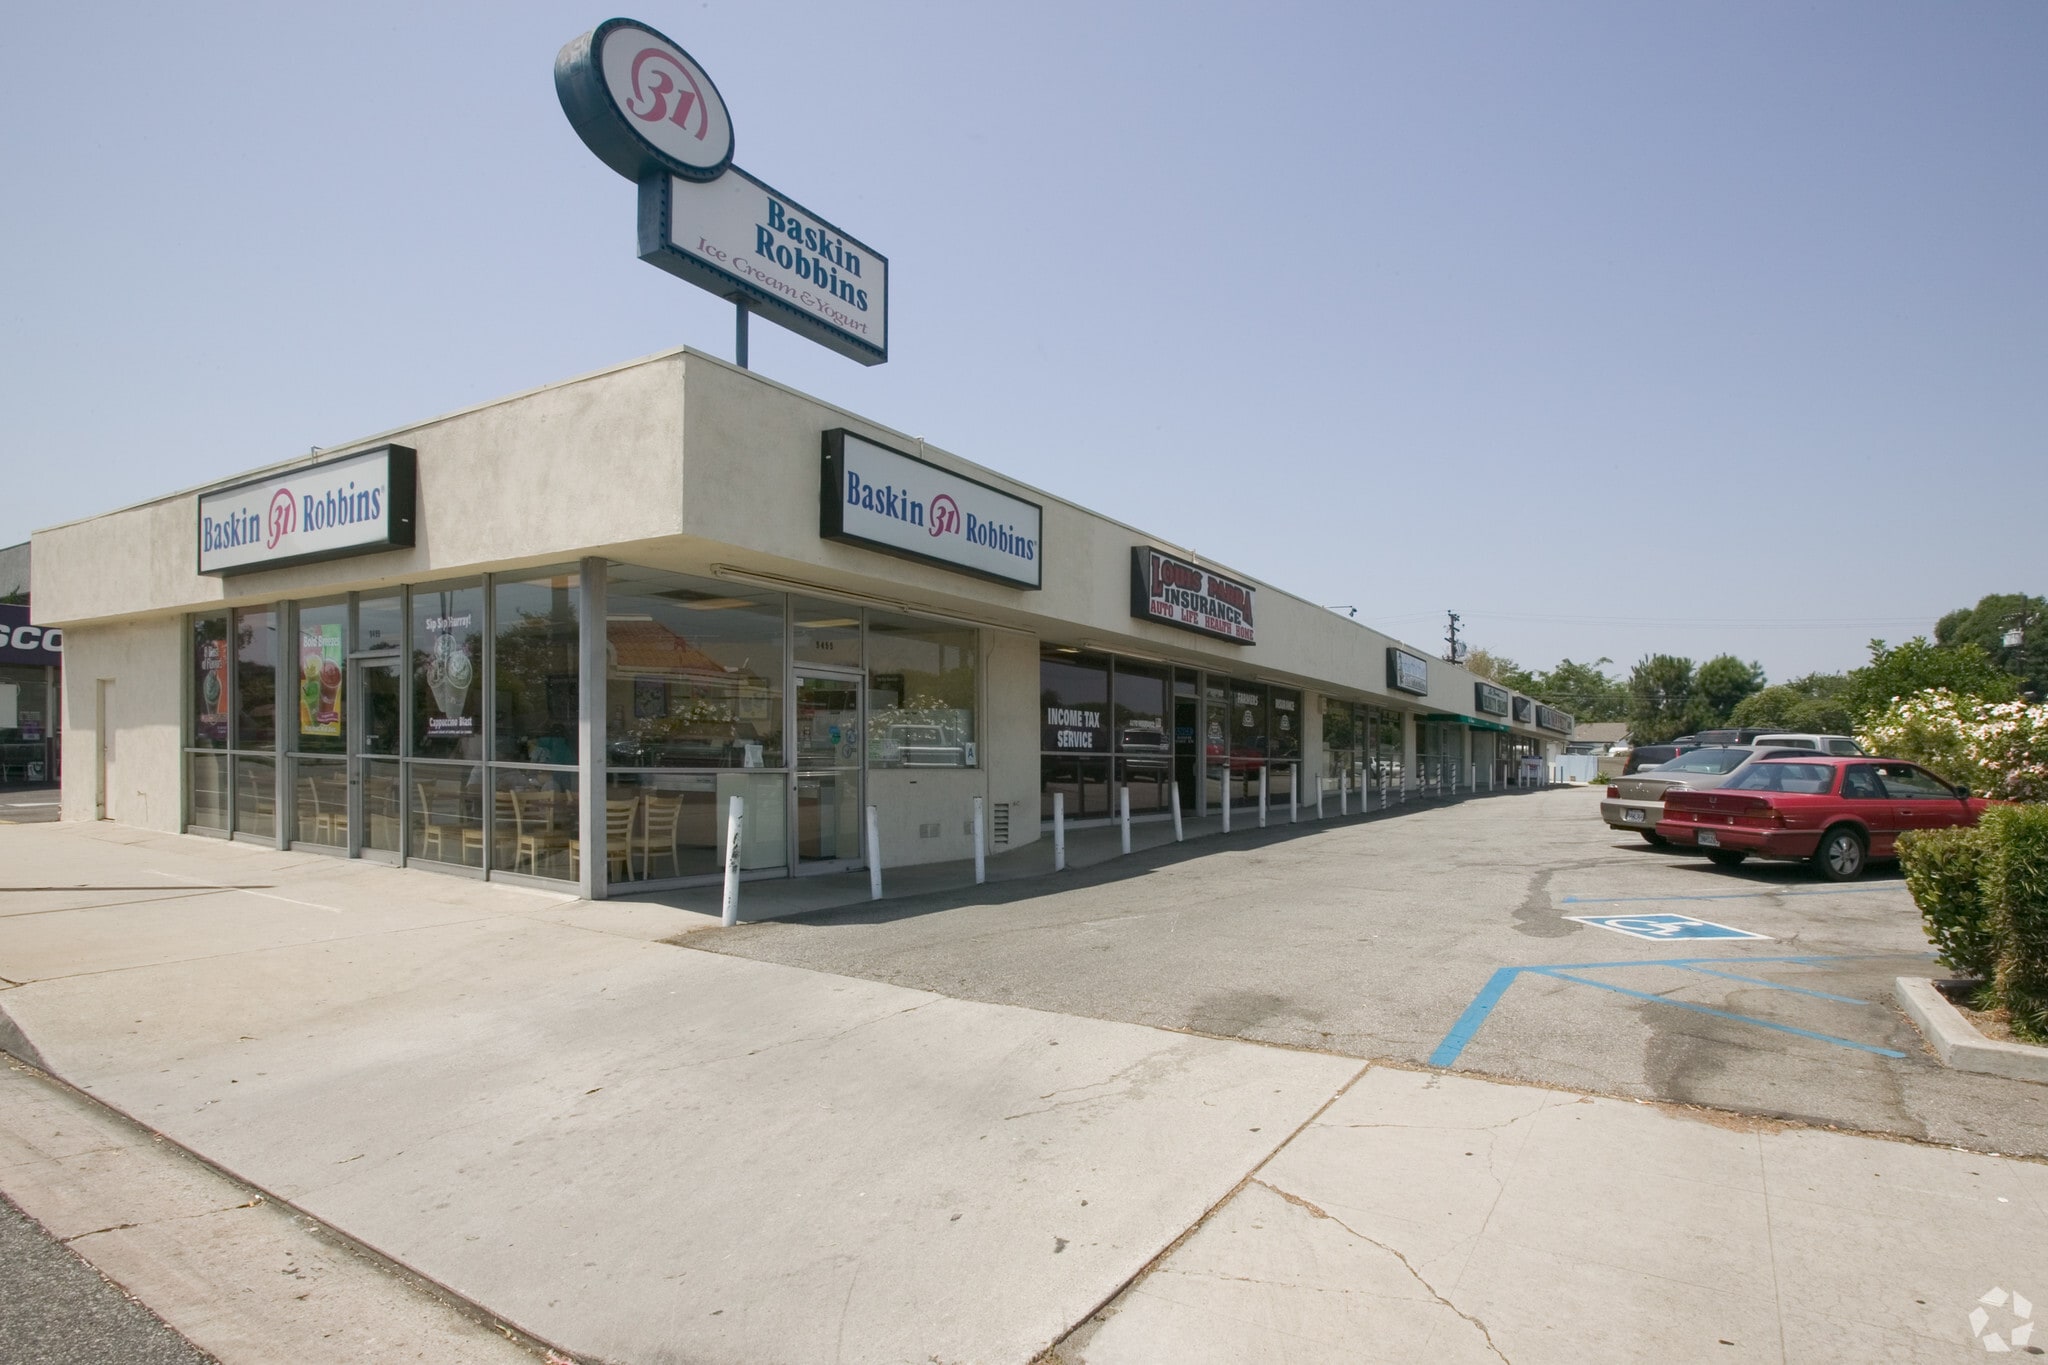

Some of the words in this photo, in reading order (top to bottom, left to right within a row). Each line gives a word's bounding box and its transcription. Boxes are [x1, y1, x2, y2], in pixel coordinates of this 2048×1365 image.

[626, 69, 696, 132] 31
[767, 197, 861, 278] Baskin
[697, 236, 727, 262] Ice
[732, 257, 798, 299] Cream
[755, 223, 868, 312] Robbins
[204, 507, 261, 552] Baskin
[267, 503, 291, 550] 31
[303, 481, 381, 533] Robbins
[847, 470, 924, 527] Baskin
[928, 505, 957, 538] 31
[966, 512, 1034, 560] Robbins
[1151, 554, 1203, 598] LOUIS
[426, 618, 437, 632] Sip
[437, 617, 448, 631] Sip
[1151, 599, 1174, 618] AUTO
[1181, 608, 1199, 625] LIFE
[1205, 615, 1232, 635] HEALTH
[1235, 625, 1254, 640] HOME
[1164, 587, 1242, 625] INSURANCE
[1048, 707, 1083, 727] INCOME
[1084, 711, 1100, 728] TAX
[1057, 730, 1093, 748] SERVICE
[967, 747, 974, 758] A
